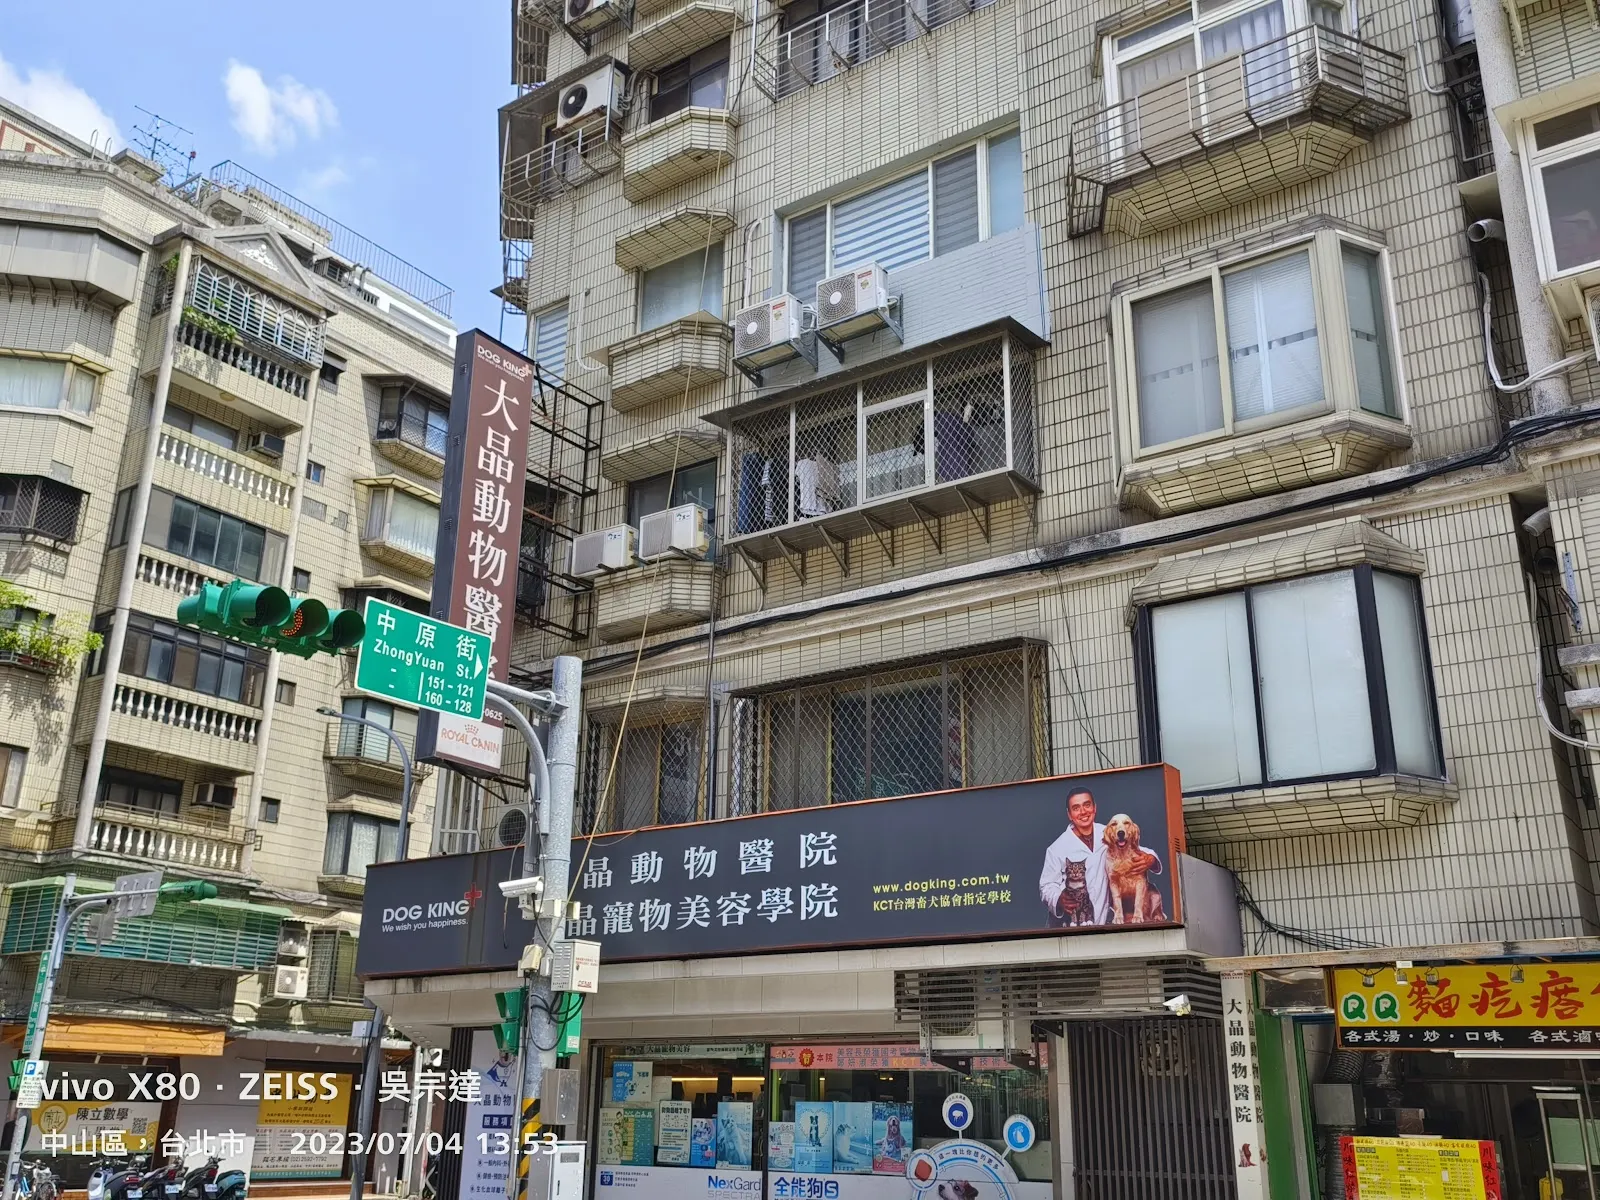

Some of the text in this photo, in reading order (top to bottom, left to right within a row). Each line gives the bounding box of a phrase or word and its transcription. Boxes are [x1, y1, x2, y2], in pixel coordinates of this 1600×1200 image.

[477, 345, 526, 378] DOG KING
[463, 379, 519, 679] 大晶動物醫
[377, 610, 476, 661] 中原街
[373, 638, 473, 680] ZhongYuan St.
[428, 675, 445, 691] 151
[457, 683, 474, 699] 121
[425, 690, 443, 706] 160
[454, 698, 472, 715] 128
[441, 728, 500, 754] ROYAL CANIN
[583, 832, 838, 889] 晶動物醫院
[873, 872, 1010, 894] www.dogking.com.tw
[382, 899, 470, 923] DOG KING
[568, 883, 839, 937] 晶寵物美容學院
[873, 889, 1012, 912] KCT台灣畜犬協會指定學校
[382, 918, 469, 933] We wish you happiness.
[1341, 970, 1600, 1024] QQ麵疙瘩
[817, 1053, 833, 1062] 本院
[1226, 998, 1252, 1123] 大晶動物醫院
[473, 1094, 516, 1107] 晶動物
[76, 1107, 129, 1121] 陳立數學
[484, 1116, 513, 1126] 服務項
[708, 1175, 761, 1191] NexGard
